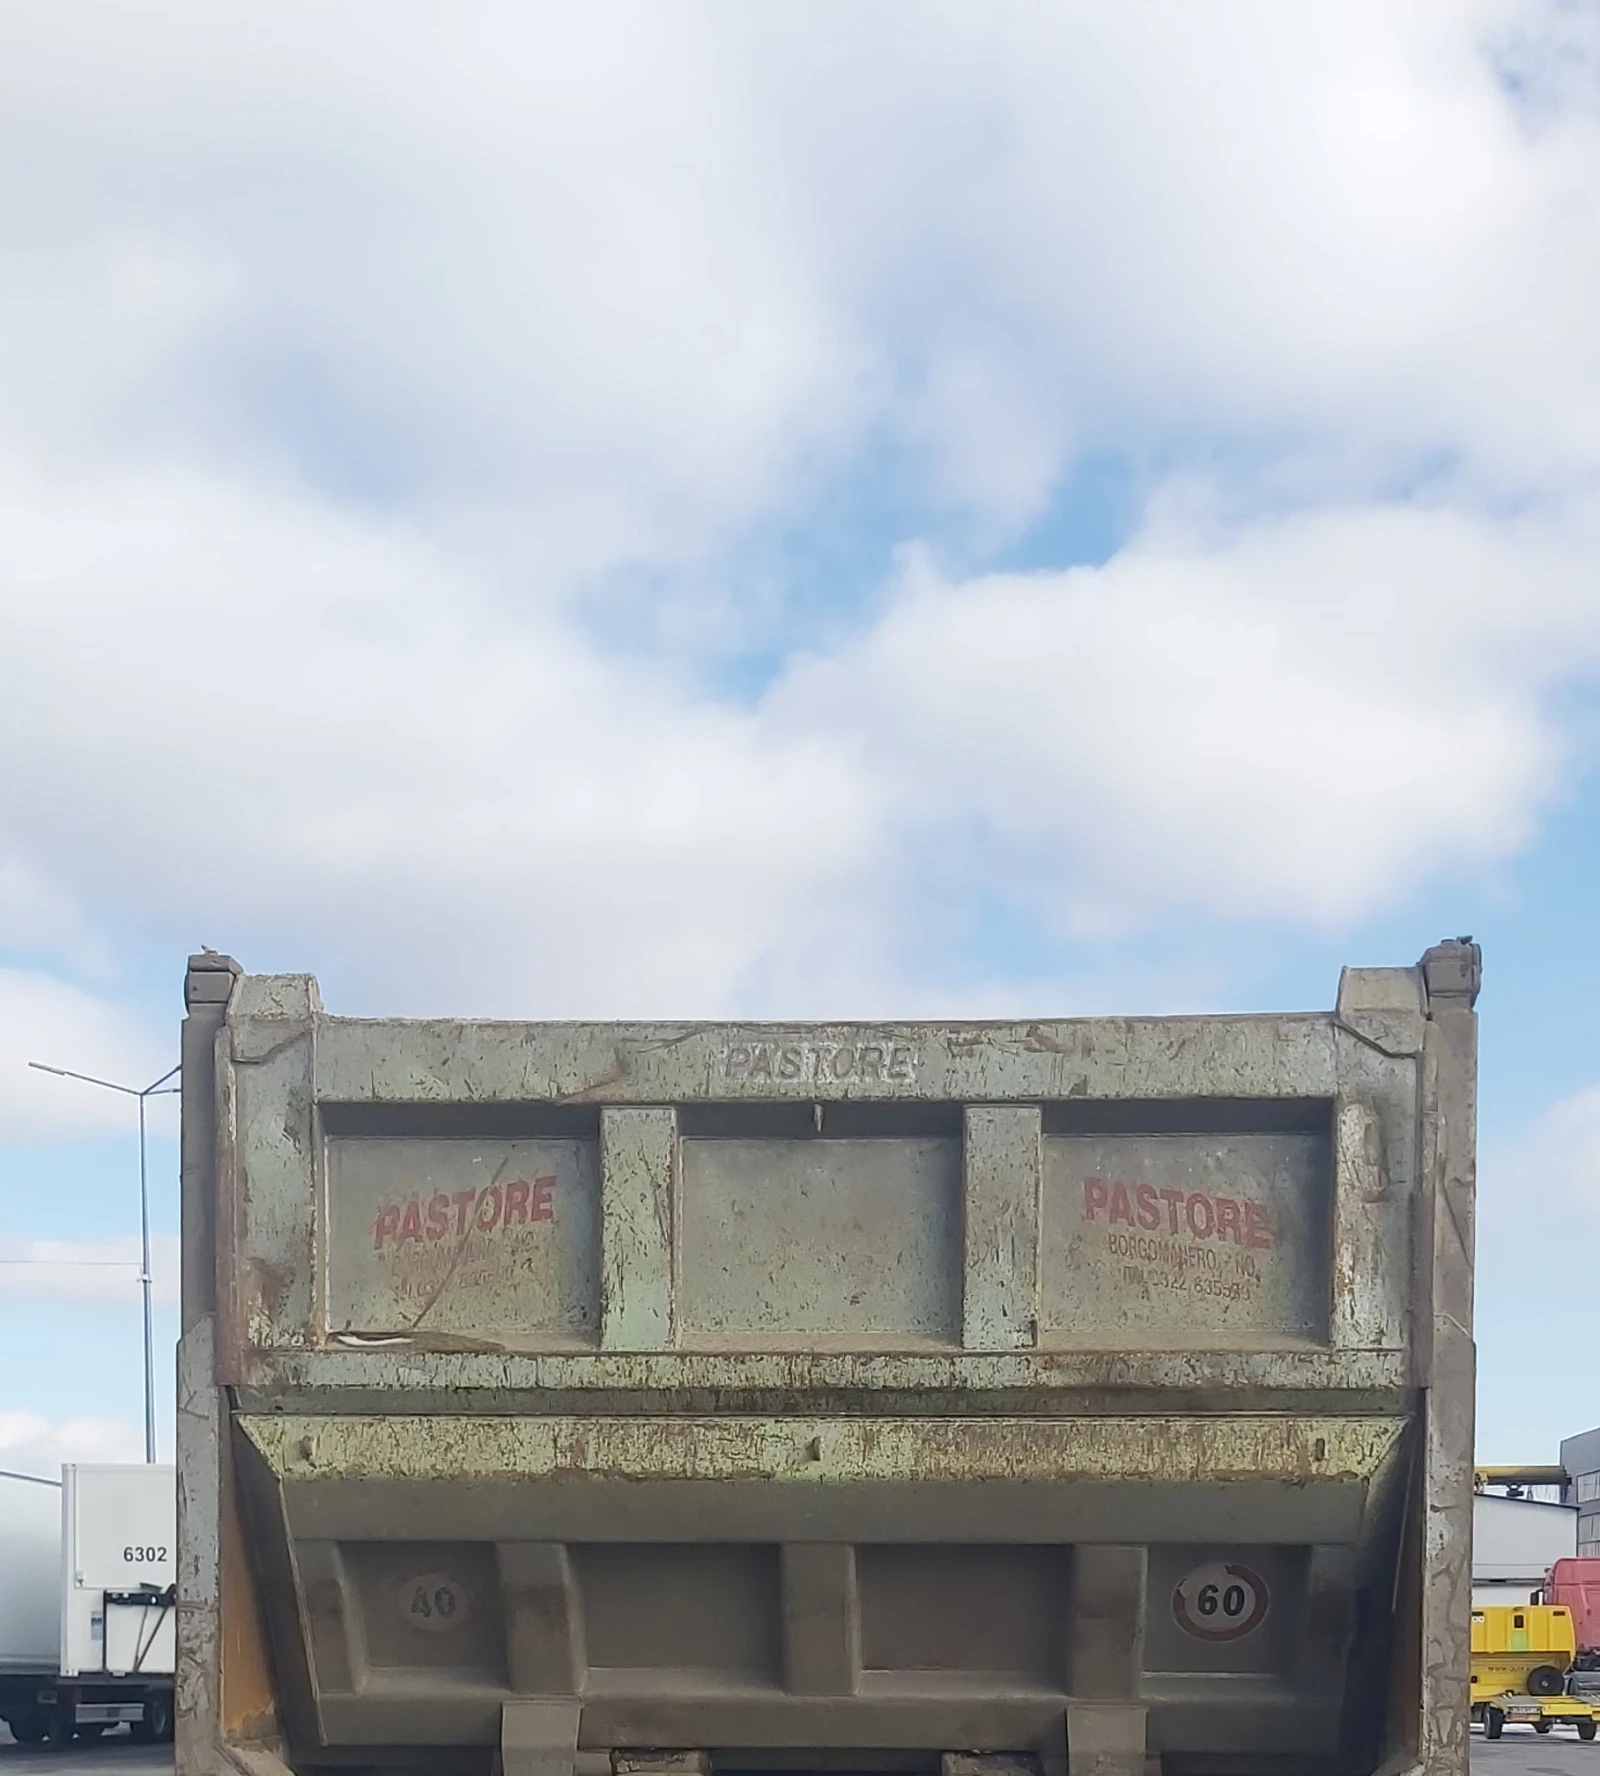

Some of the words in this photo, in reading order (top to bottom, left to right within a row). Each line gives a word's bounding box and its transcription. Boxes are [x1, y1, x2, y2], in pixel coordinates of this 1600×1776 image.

[724, 1043, 916, 1082] PASTORE
[373, 1175, 558, 1251] PASTORE
[1083, 1176, 1274, 1250] PASTORE
[123, 1546, 168, 1563] 6302
[410, 1585, 456, 1618] 40
[1197, 1584, 1245, 1617] 60
